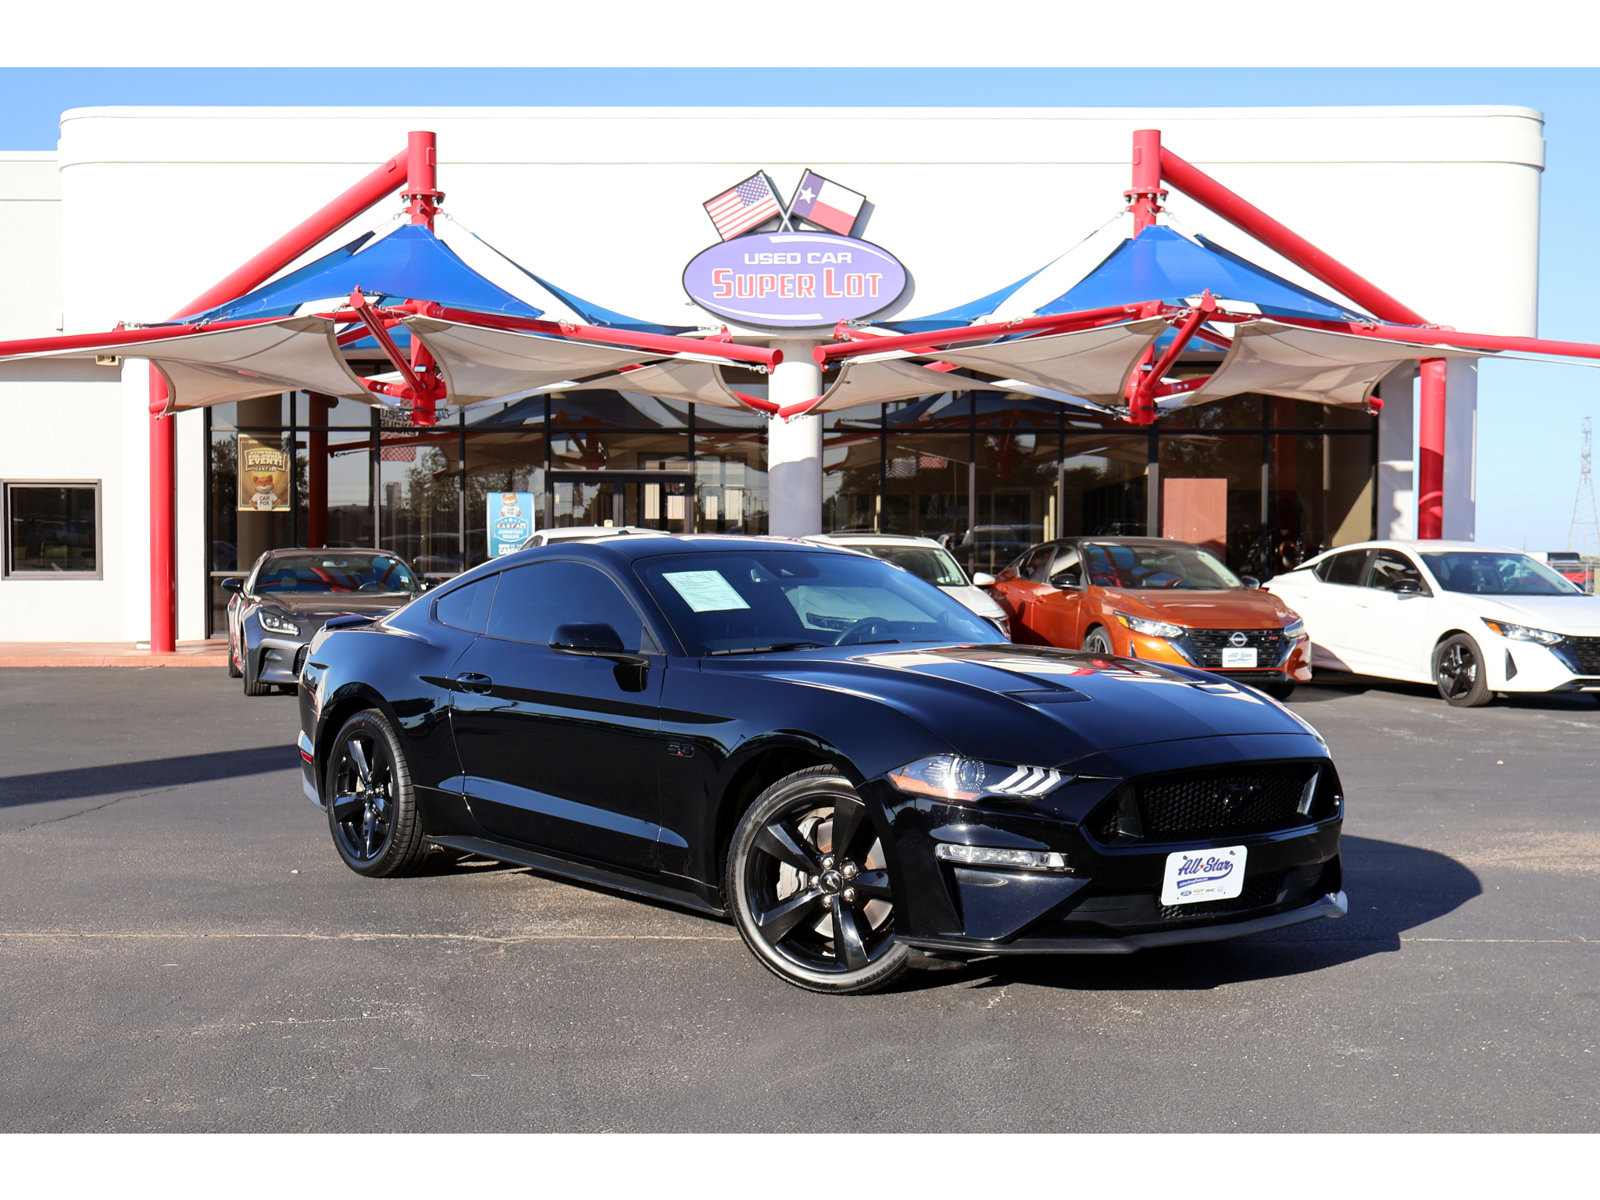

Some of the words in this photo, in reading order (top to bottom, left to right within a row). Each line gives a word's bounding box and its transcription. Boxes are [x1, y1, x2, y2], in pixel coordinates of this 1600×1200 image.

[744, 252, 801, 265] USED
[807, 252, 852, 265] CAR
[711, 267, 816, 299] SUPER
[823, 267, 883, 299] LOT
[248, 458, 282, 466] EVENT!
